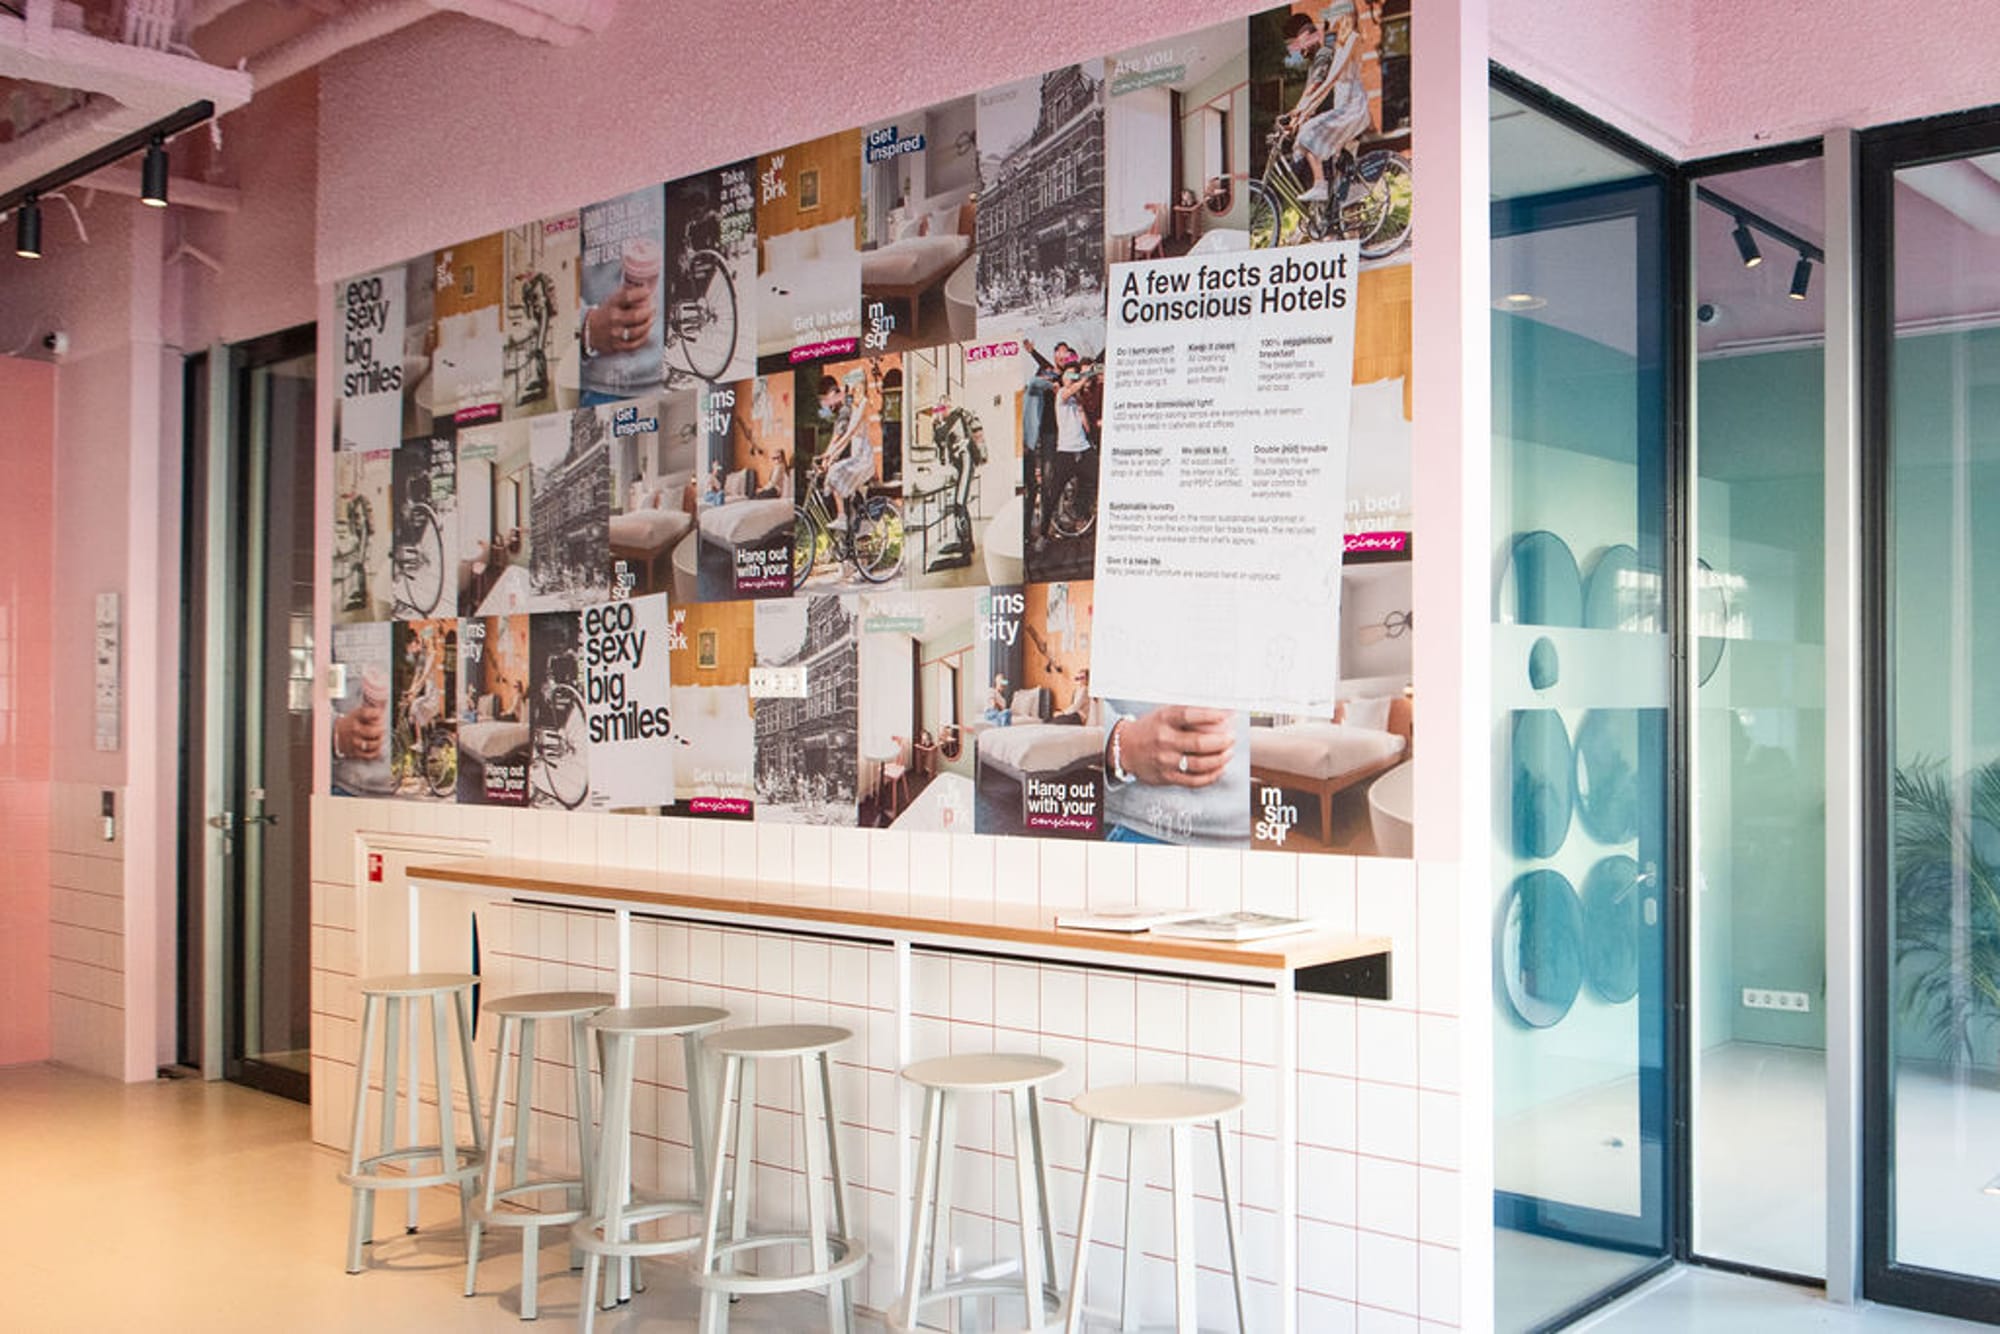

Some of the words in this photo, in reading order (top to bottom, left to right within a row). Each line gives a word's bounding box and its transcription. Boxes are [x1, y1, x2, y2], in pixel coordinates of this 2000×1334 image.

[870, 127, 893, 146] Get
[870, 133, 921, 161] inspired
[1122, 271, 1139, 297] A
[1147, 270, 1190, 295] few
[1199, 264, 1260, 290] facts
[1269, 253, 1347, 285] about
[347, 278, 382, 305] eco
[1122, 293, 1250, 324] Conscious
[1261, 282, 1346, 314] Hotels
[346, 301, 390, 333] sexy
[869, 302, 884, 320] m
[870, 315, 896, 334] sm
[345, 331, 371, 369] big
[864, 330, 890, 351] sqr
[344, 359, 401, 398] smiles
[738, 547, 766, 565] Hang
[768, 545, 788, 561] out
[762, 563, 789, 579] your
[586, 603, 633, 638] eco
[981, 614, 1020, 646] city
[586, 629, 647, 669] sexy
[587, 666, 625, 711] big
[589, 703, 671, 744] smiles
[1028, 778, 1066, 801] Hang
[1070, 782, 1095, 798] out
[1261, 787, 1282, 806] m
[1028, 796, 1060, 813] with
[1062, 801, 1097, 818] your
[1264, 804, 1298, 825] sm
[1031, 817, 1094, 830] conscious
[1255, 820, 1291, 847] sqr
